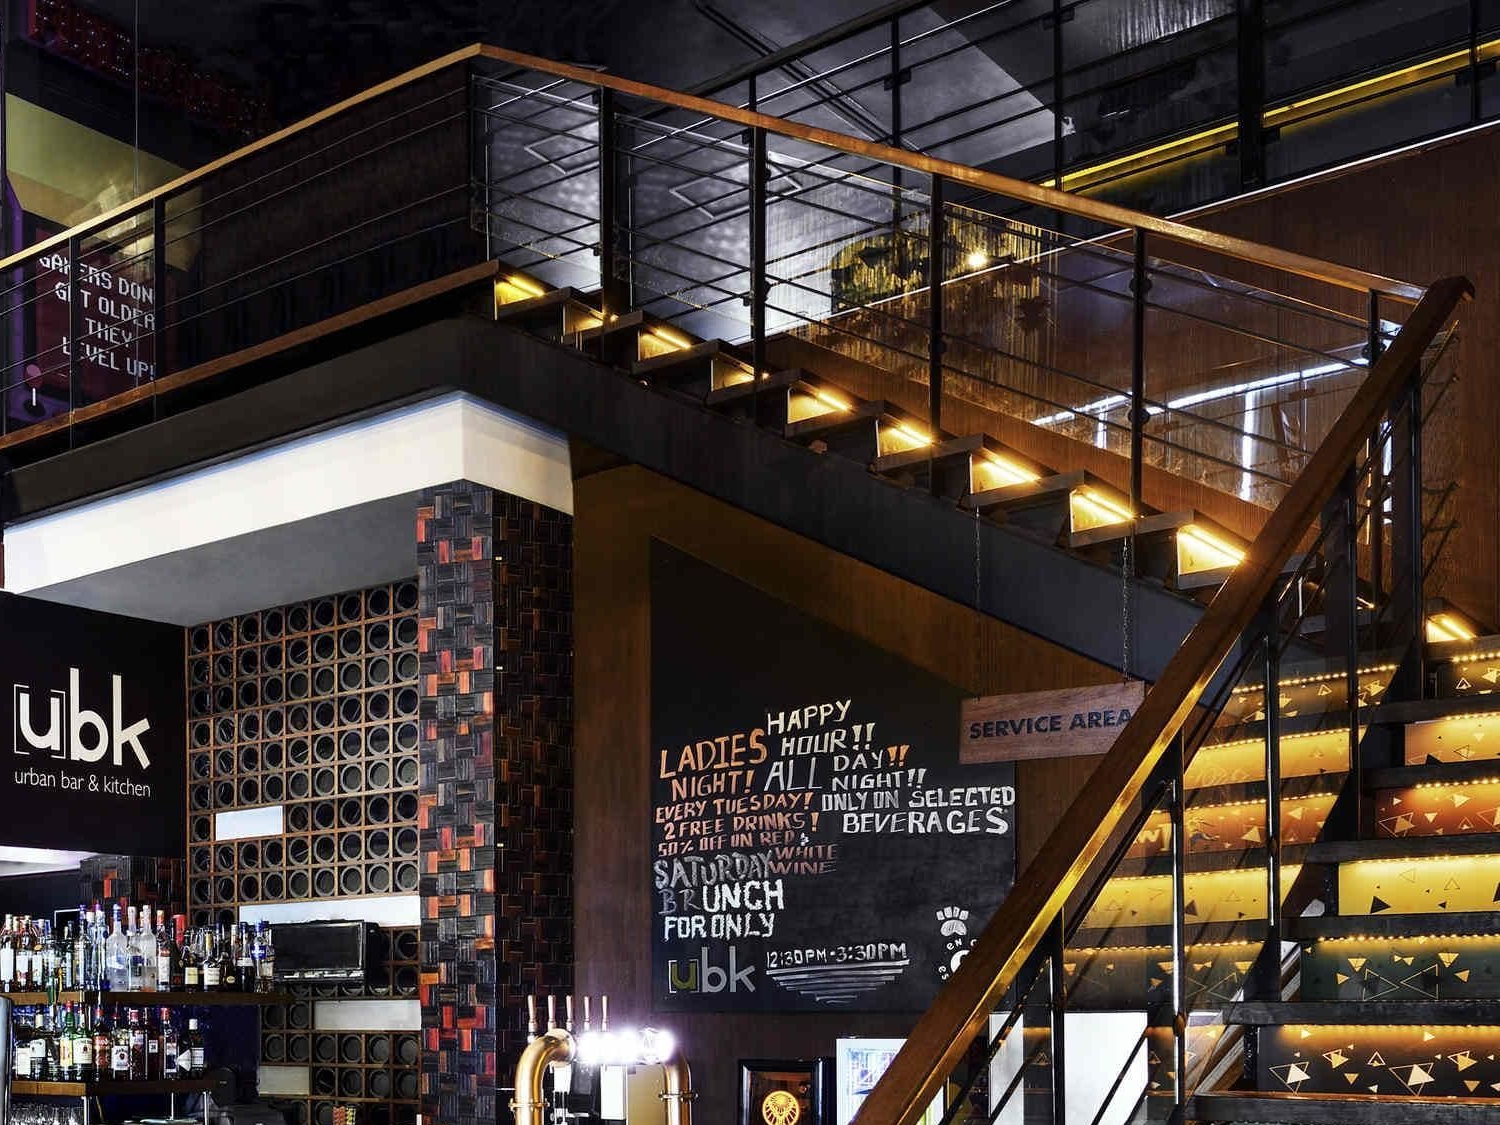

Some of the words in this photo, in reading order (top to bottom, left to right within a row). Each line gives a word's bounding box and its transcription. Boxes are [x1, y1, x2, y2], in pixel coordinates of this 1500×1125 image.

[55, 282, 91, 308] GT
[98, 296, 155, 331] OLDER
[85, 317, 132, 347] THEY
[126, 357, 155, 381] UP!
[767, 699, 851, 735] HAPPY
[969, 715, 1062, 740] SERVICE
[1069, 708, 1132, 730] AREA
[660, 728, 768, 779] LADIES
[781, 722, 876, 756] HOUR!!
[14, 767, 56, 787] urban
[61, 771, 84, 792] bar
[88, 774, 100, 792] &
[103, 776, 151, 798] kitchen
[764, 757, 822, 791] ALL
[834, 744, 910, 771] DAY!!
[832, 768, 927, 791] NIGHT!!
[672, 770, 755, 801] NIGHT!
[821, 791, 868, 811] ONLY
[873, 789, 900, 809] ON
[908, 786, 1016, 808] SELECTED
[656, 801, 707, 823] EVERY
[713, 791, 813, 815] TUESDAY!
[842, 807, 1009, 834] BEVERAGES
[658, 839, 694, 857] 50%
[700, 833, 728, 850] OFF
[730, 832, 753, 848] ON
[760, 831, 794, 845] RED
[663, 822, 676, 841] 2
[679, 818, 725, 837] FREE
[769, 860, 836, 875] WINE
[775, 843, 838, 861] WHITE
[653, 850, 772, 889] SATURDAY
[658, 879, 784, 915] BRUNCH
[662, 914, 707, 942] FOR
[711, 913, 775, 940] ONLY
